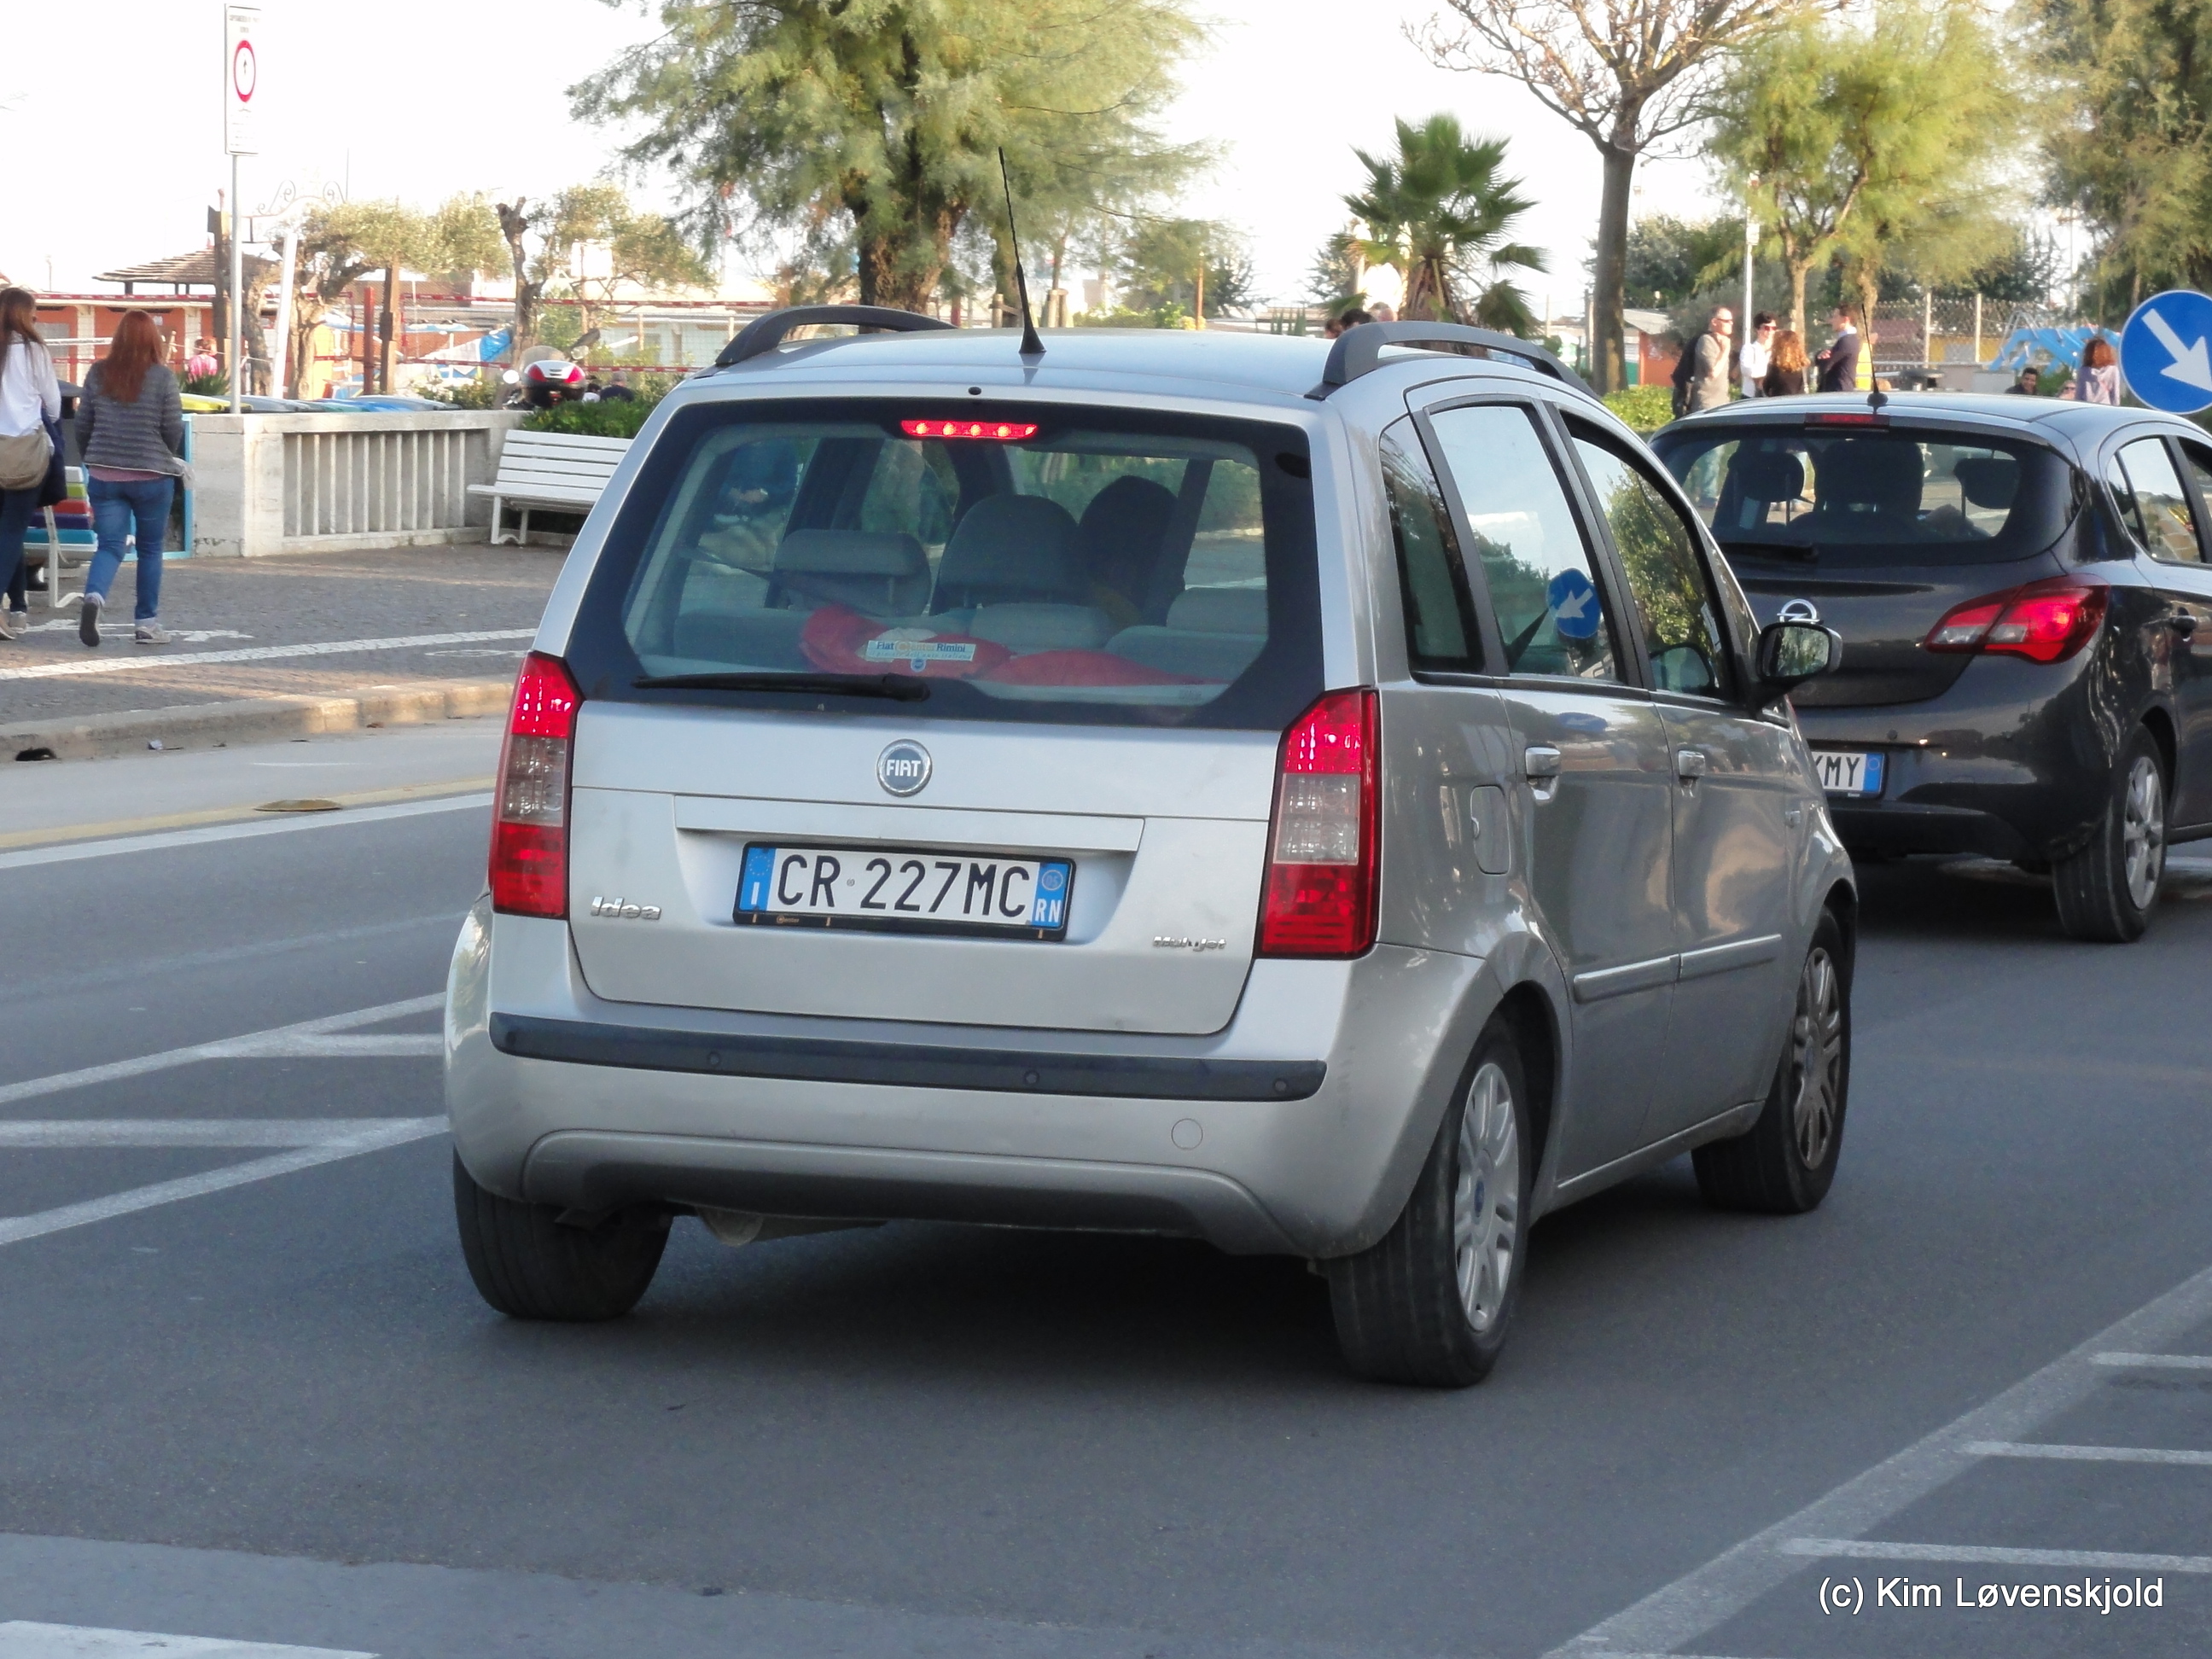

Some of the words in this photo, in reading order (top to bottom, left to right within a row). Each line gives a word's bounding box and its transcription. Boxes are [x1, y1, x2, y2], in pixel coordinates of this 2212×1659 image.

[876, 641, 894, 649] Fiat
[935, 643, 966, 653] Rimini
[886, 759, 922, 777] FIAT
[777, 854, 841, 908] CR
[859, 857, 1030, 917] 227MC
[1034, 898, 1062, 923] RN
